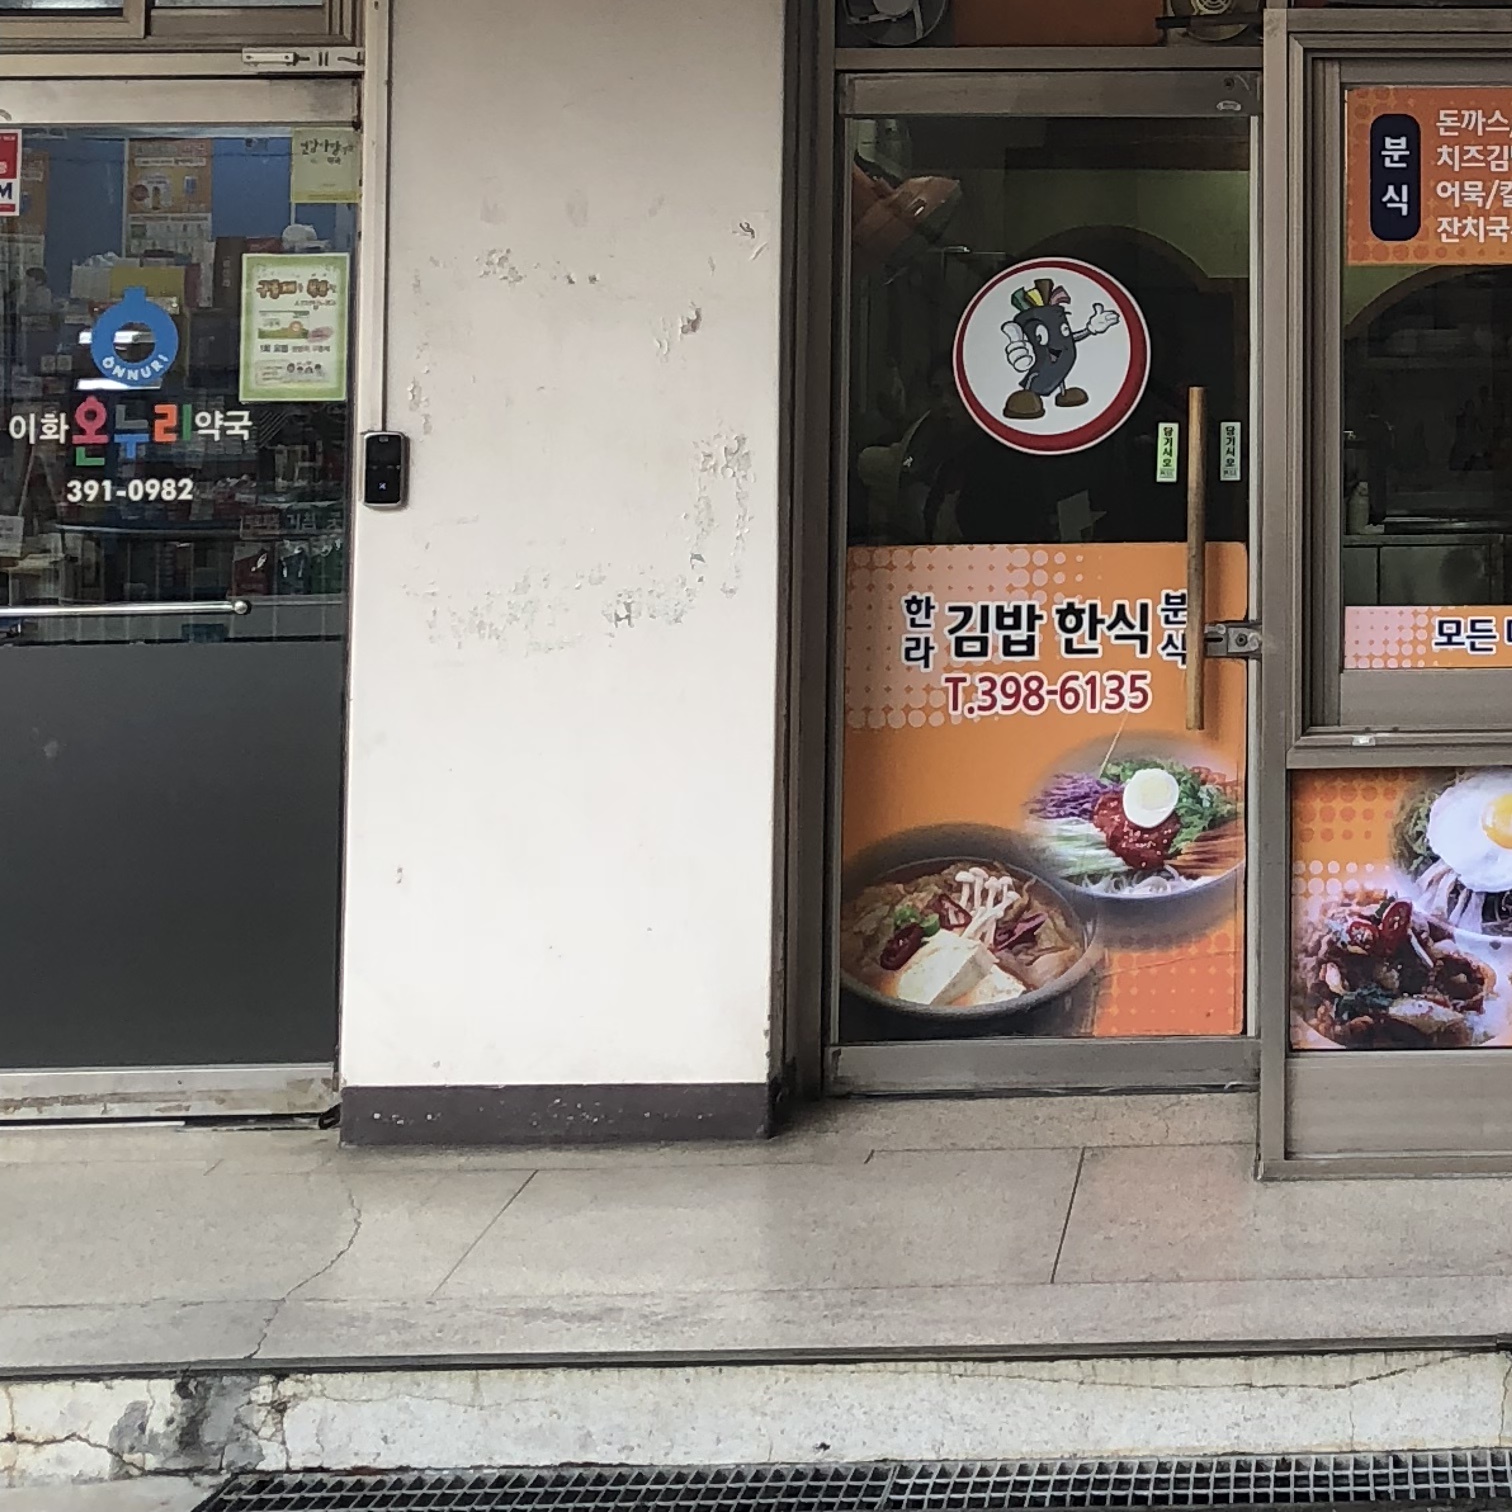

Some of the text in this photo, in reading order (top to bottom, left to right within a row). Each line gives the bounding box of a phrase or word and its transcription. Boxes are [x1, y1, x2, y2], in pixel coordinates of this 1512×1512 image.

[1380, 136, 1410, 216] 분식
[102, 354, 169, 381] ONNURI
[66, 477, 195, 503] 391-0982
[904, 595, 936, 669] 한라
[947, 602, 1044, 657] 김밥
[1054, 601, 1150, 655] 한식
[1433, 618, 1495, 653] 모든
[944, 673, 1149, 716] T.398-6135
